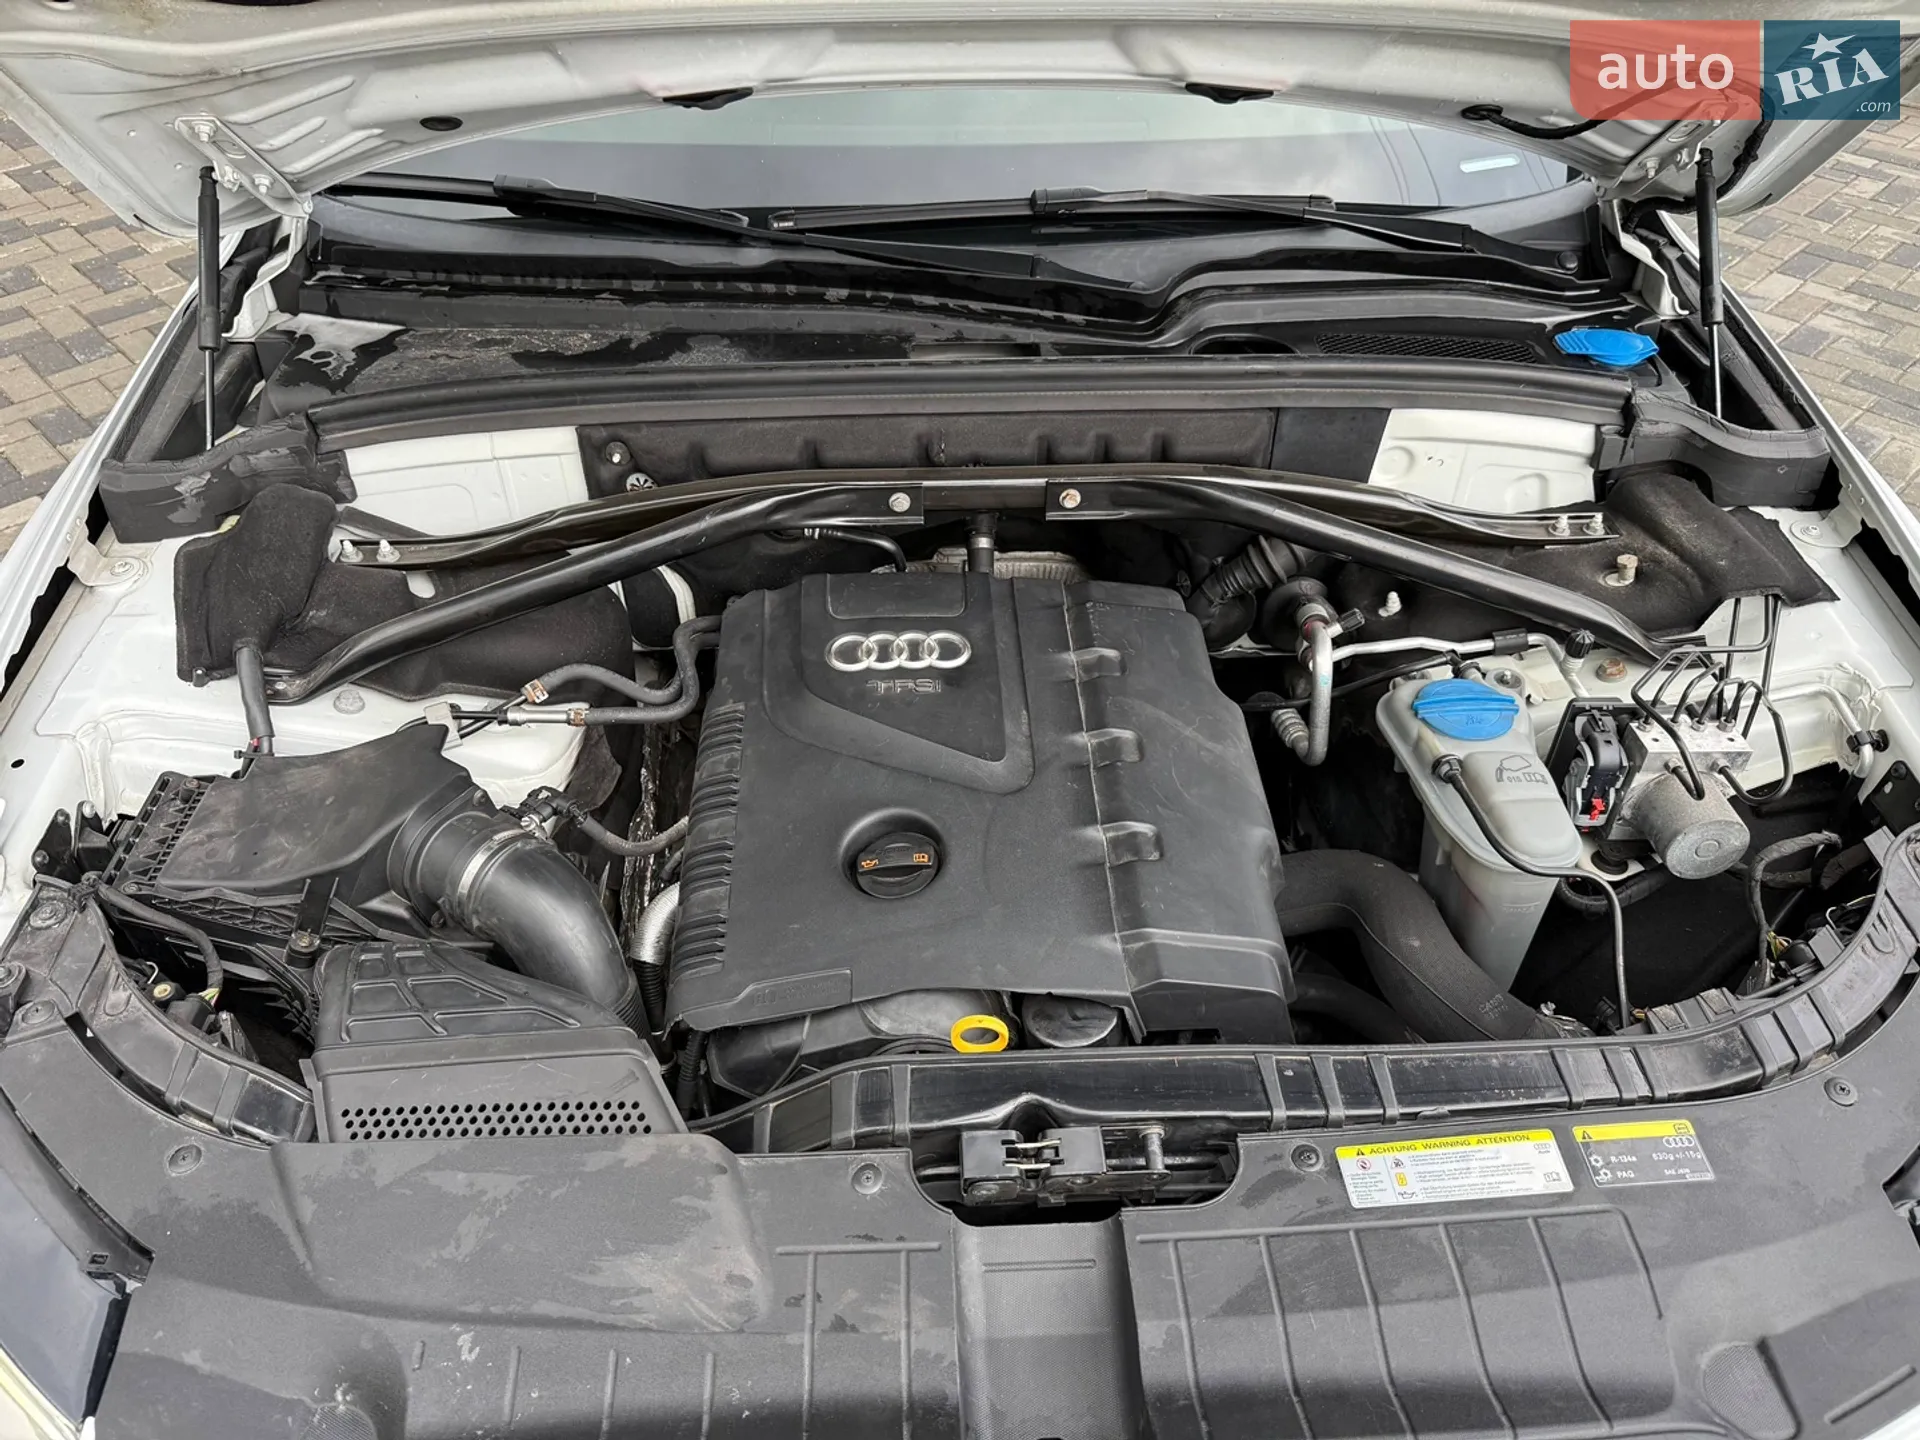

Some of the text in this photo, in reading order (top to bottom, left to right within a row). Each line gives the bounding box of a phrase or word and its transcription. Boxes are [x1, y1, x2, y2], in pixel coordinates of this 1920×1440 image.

[866, 679, 941, 695] TFSI
[1369, 1134, 1530, 1155] ACHTUNG WARNING ATTENTION
[1609, 1154, 1637, 1164] R-134a
[1616, 1170, 1635, 1179] PAG
